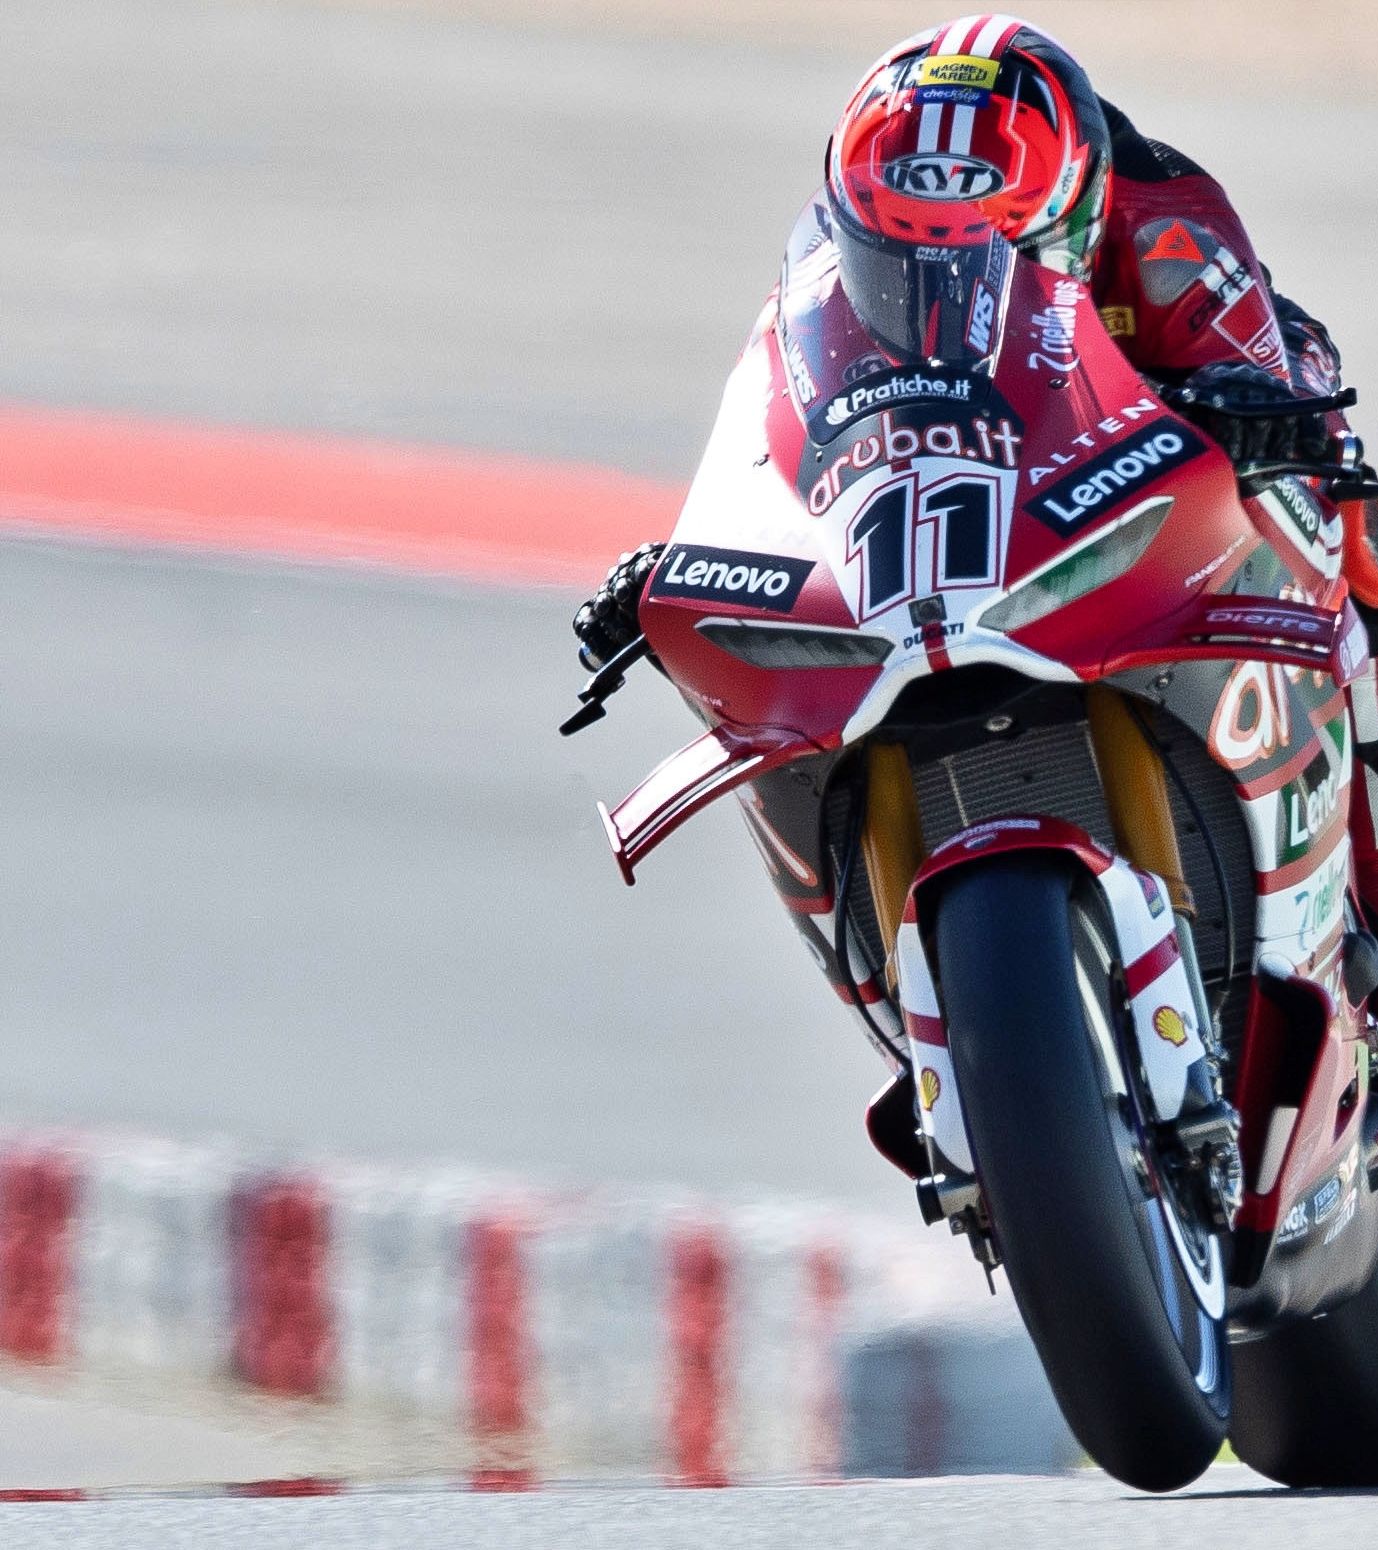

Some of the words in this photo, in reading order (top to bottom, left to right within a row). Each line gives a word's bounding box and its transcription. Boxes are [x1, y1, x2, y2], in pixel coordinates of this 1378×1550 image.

[893, 162, 991, 194] KYT
[850, 373, 971, 411] Pratiche.it
[808, 410, 1023, 517] aruba.it
[1028, 398, 1158, 486] ALTEN
[1043, 433, 1183, 522] Lenovo
[664, 552, 791, 597] Lenovo
[848, 474, 998, 622] 11
[904, 622, 964, 650] DUCATI
